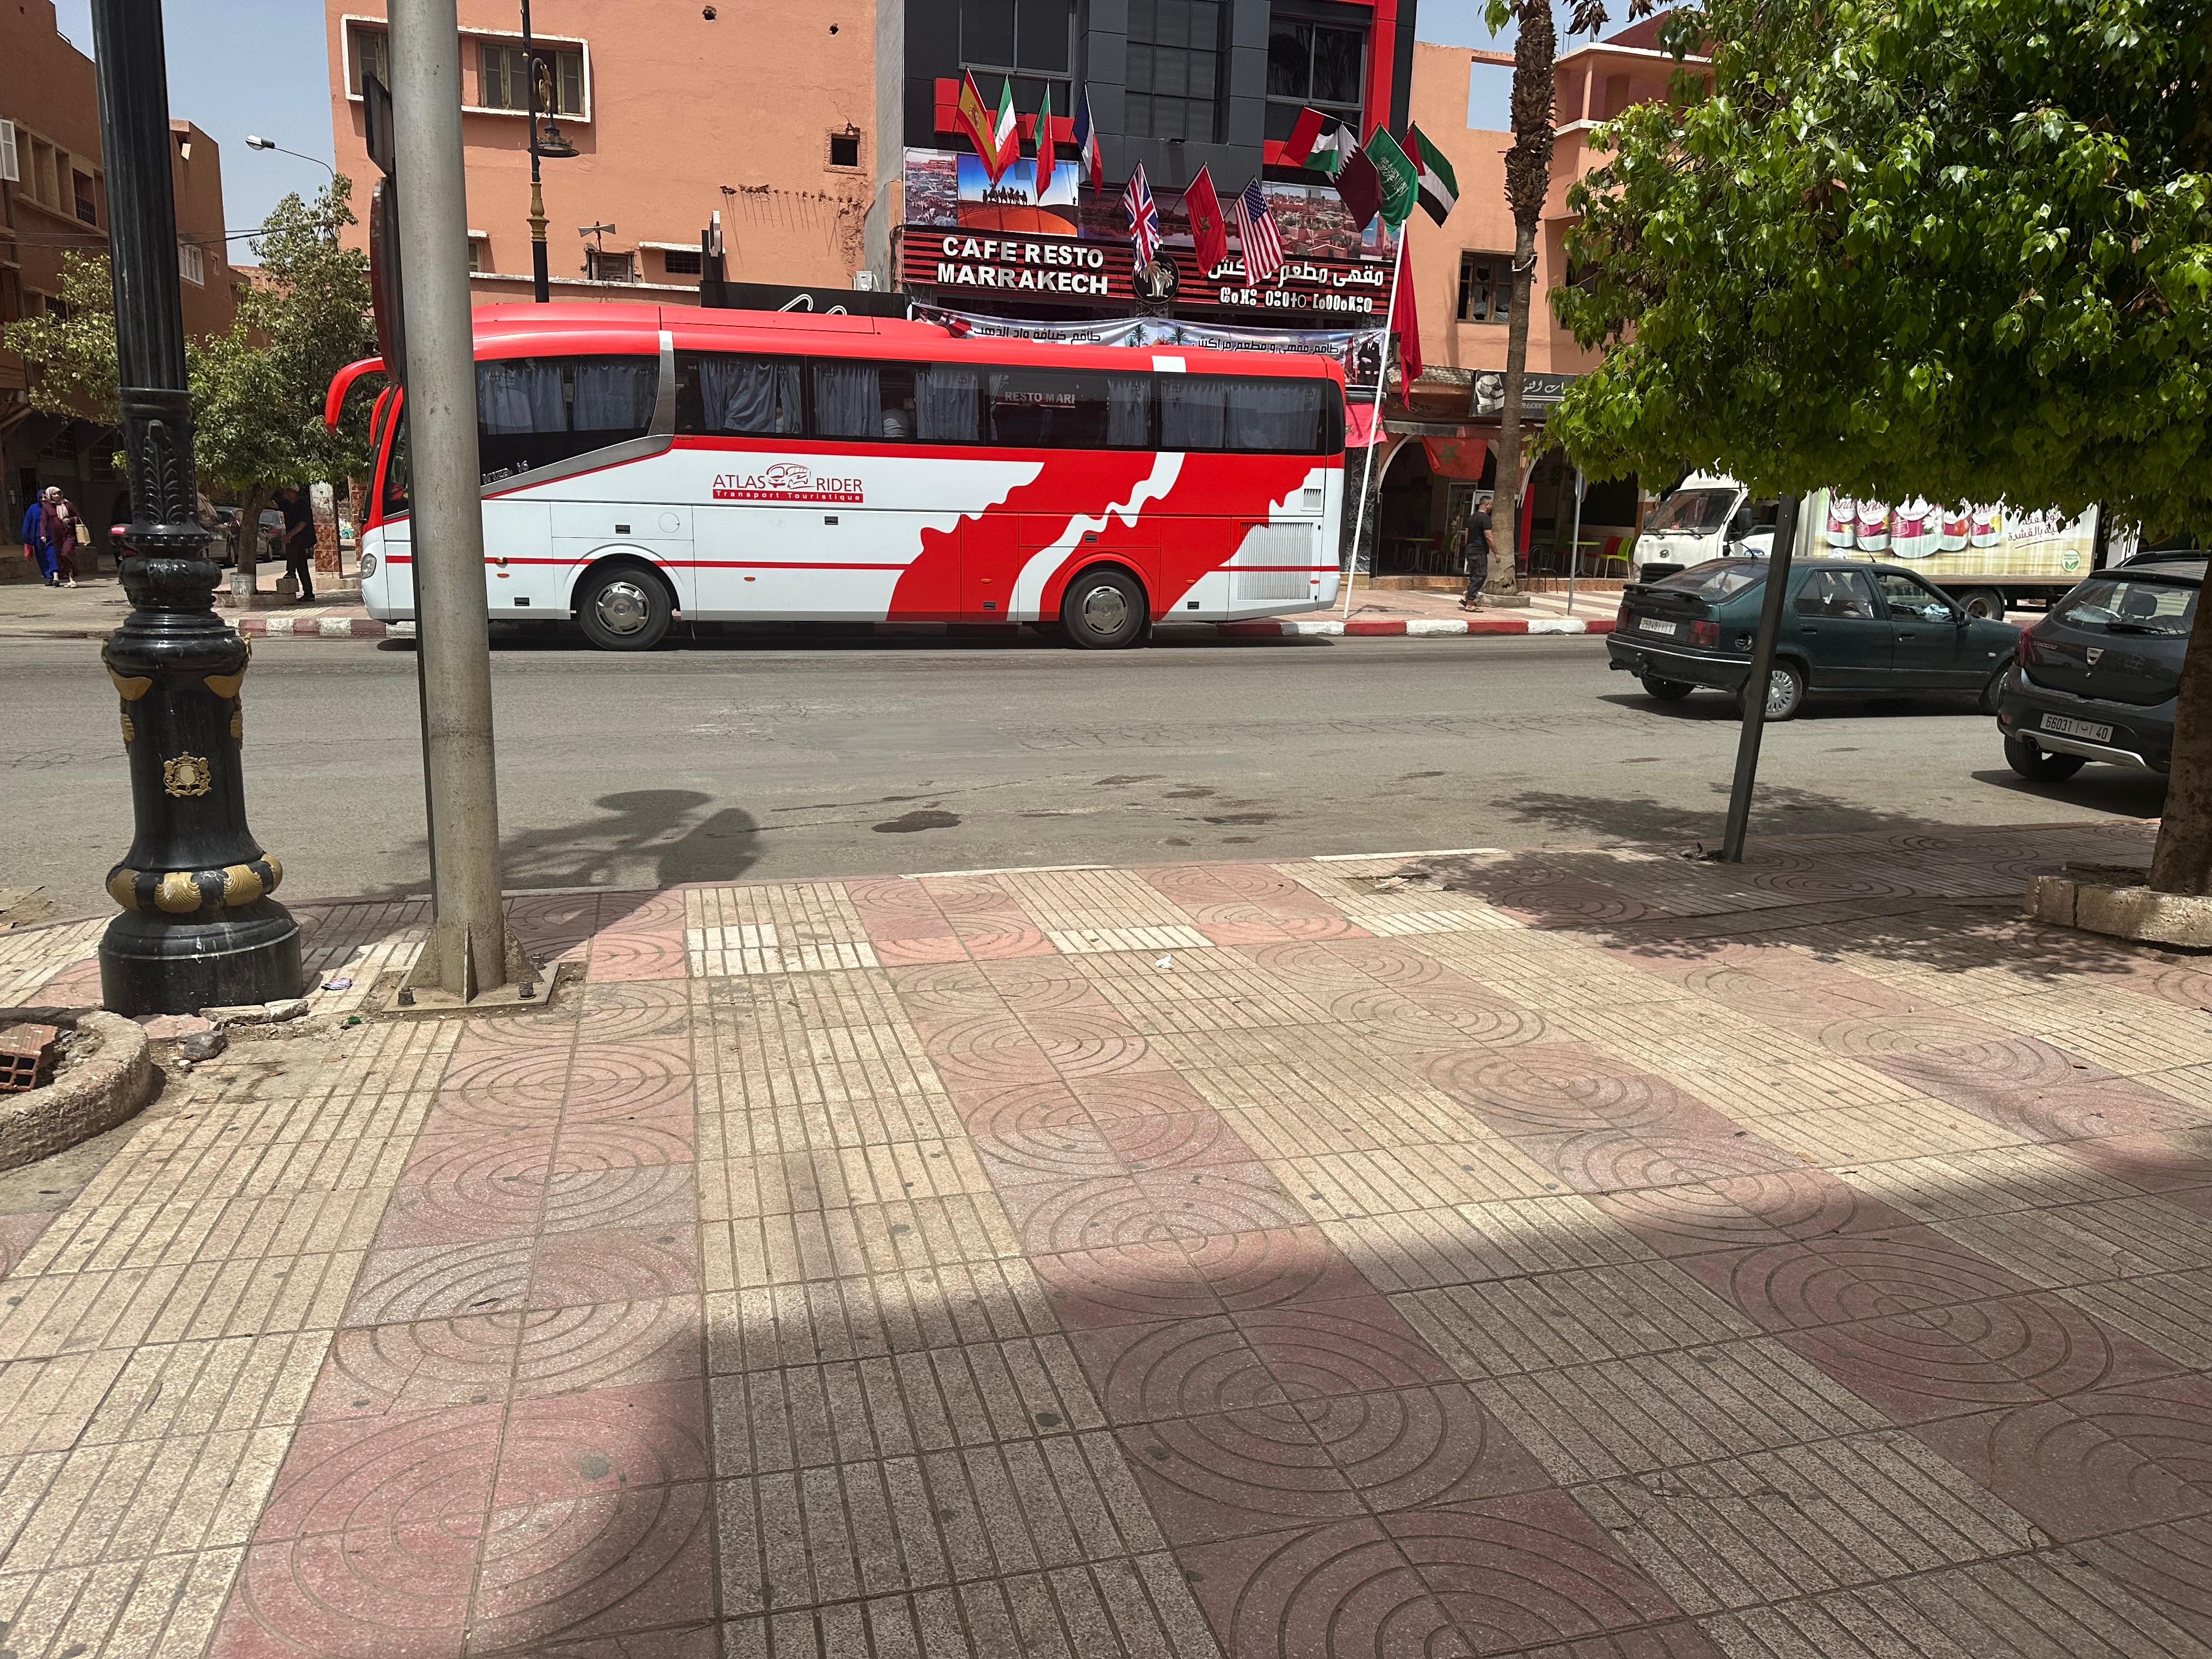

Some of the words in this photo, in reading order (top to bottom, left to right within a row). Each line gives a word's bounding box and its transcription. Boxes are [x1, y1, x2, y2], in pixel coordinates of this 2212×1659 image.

[943, 237, 1019, 262] CAFE
[1024, 244, 1104, 268] RESTO
[938, 263, 1108, 295] MARRAKECH
[1278, 261, 1328, 288] مطعم
[1333, 265, 1384, 287] مقهى
[973, 325, 1009, 337] الذهب
[1013, 328, 1030, 339] واد
[1033, 328, 1066, 344] ضيافة
[1070, 330, 1101, 345] طاقم
[1192, 335, 1232, 352] مراكش
[1234, 340, 1267, 352] مطعم
[1278, 341, 1309, 354] مقهى
[1312, 342, 1339, 355] طاقم
[1005, 391, 1042, 403] RESTO
[713, 474, 766, 489] ATLAS
[816, 477, 863, 492] RIDER
[715, 490, 780, 499] Transport
[787, 492, 860, 501] Touristique
[2045, 716, 2072, 732] 66031
[2096, 726, 2108, 740] 40
